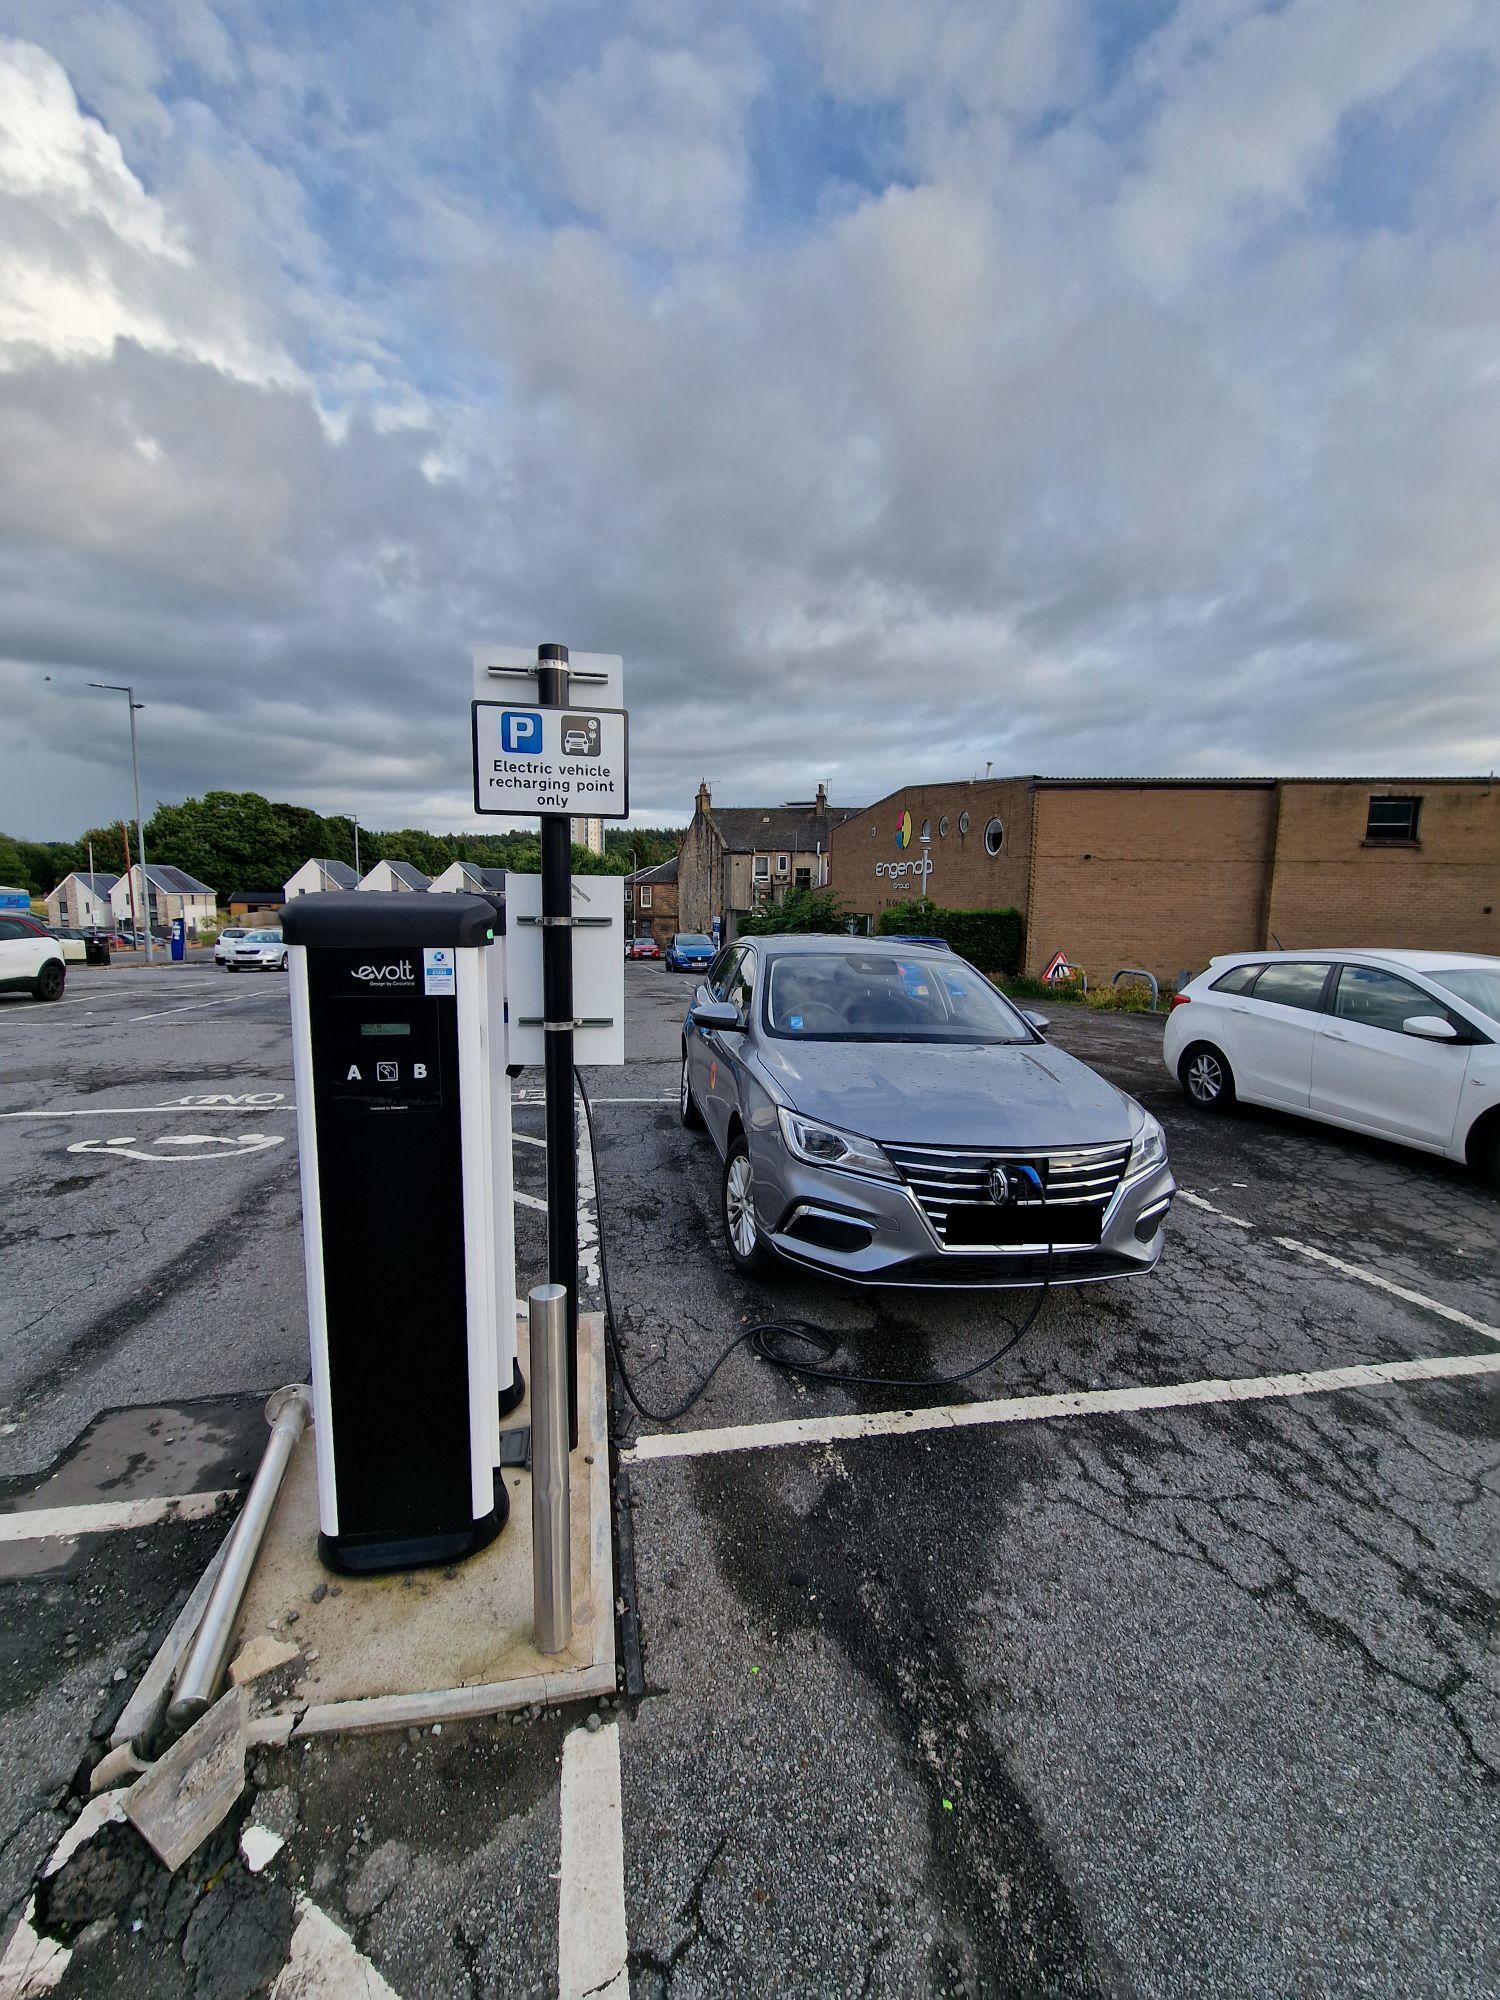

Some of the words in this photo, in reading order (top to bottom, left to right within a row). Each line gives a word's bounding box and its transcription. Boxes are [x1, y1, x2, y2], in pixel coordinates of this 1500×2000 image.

[510, 716, 534, 749] P
[493, 759, 553, 774] Electric
[558, 764, 611, 777] vehicle
[489, 776, 570, 793] recharging
[576, 780, 615, 793] point
[537, 795, 569, 808] only
[893, 882, 910, 890] Group
[351, 960, 415, 980] evolt
[347, 1064, 362, 1080] A
[413, 1063, 428, 1079] B
[156, 1092, 285, 1107] ONLY
